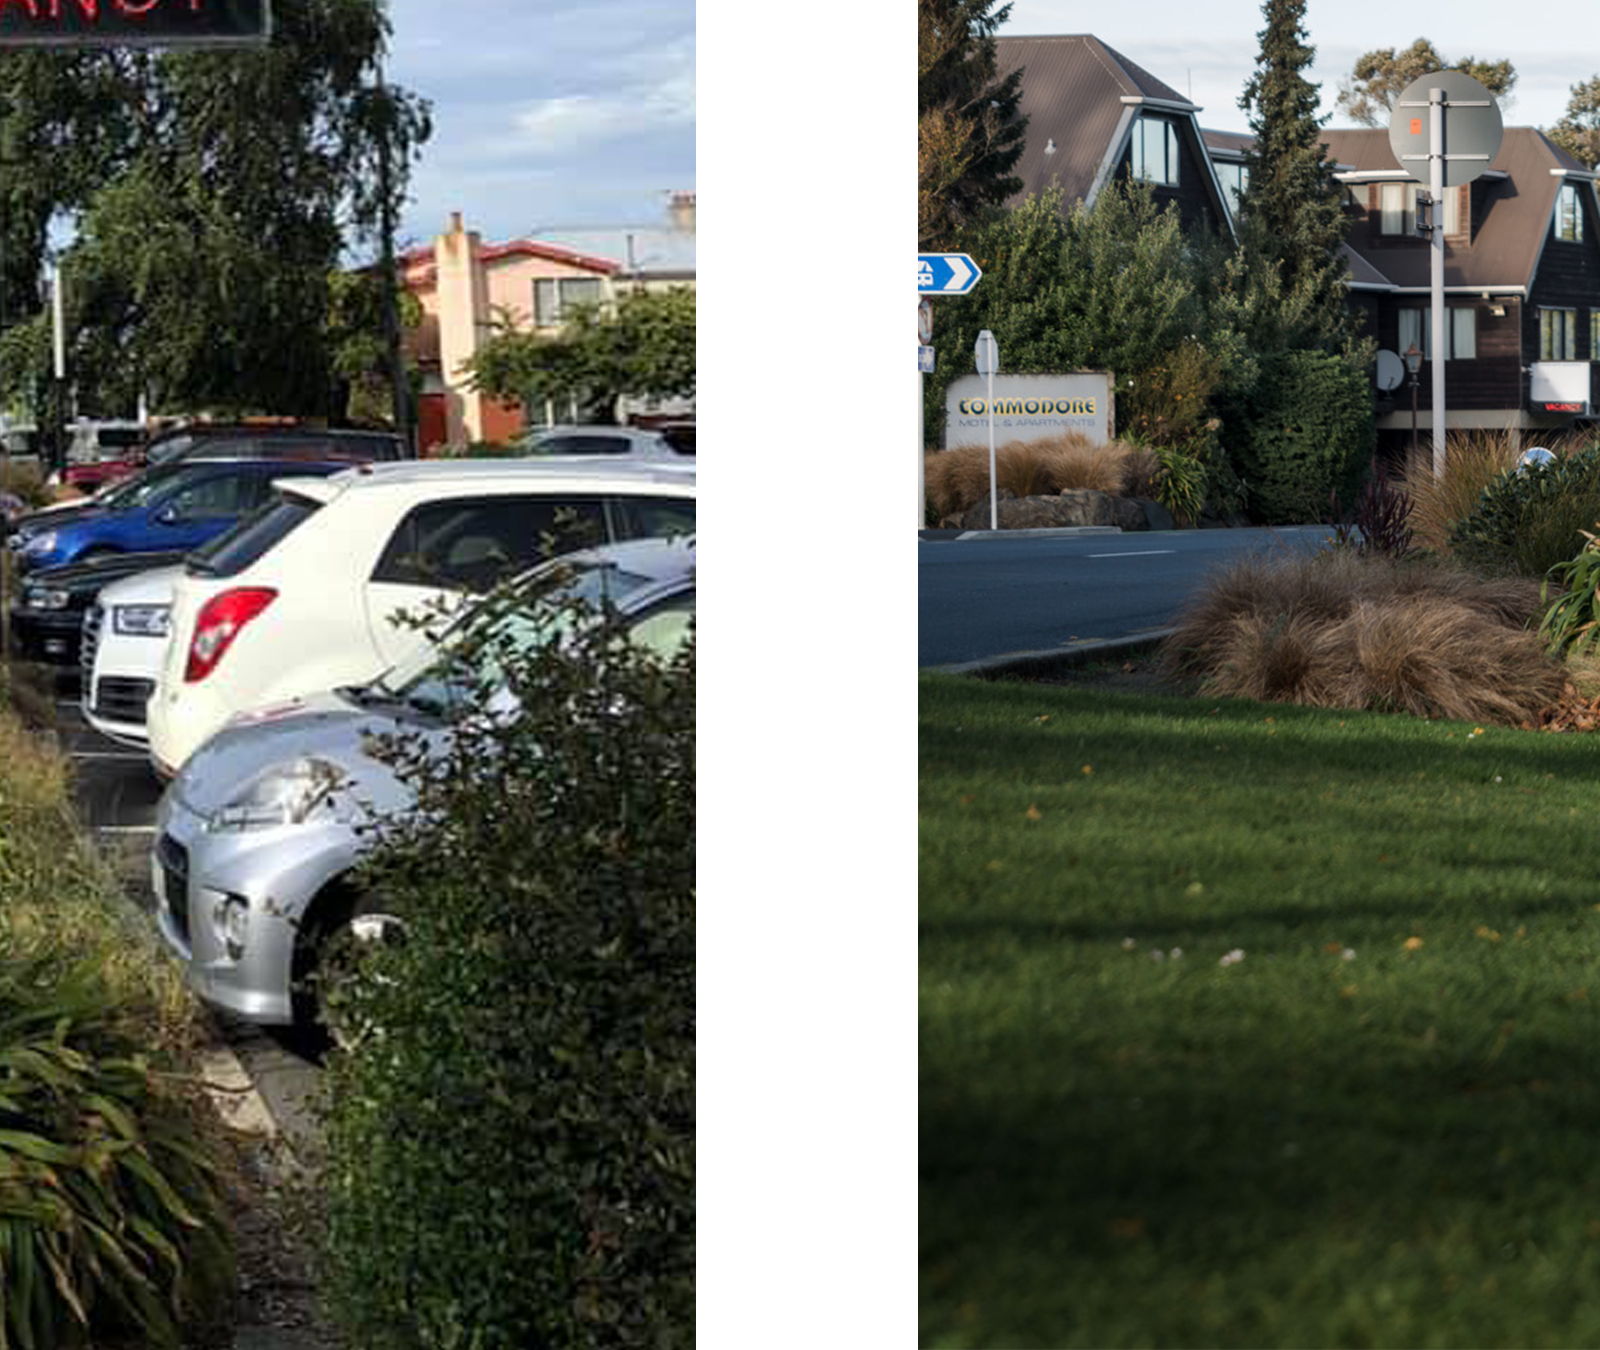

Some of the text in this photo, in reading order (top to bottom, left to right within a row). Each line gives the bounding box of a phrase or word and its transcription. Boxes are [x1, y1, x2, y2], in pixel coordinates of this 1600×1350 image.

[1544, 402, 1582, 412] VACANCY
[1003, 418, 1013, 428] &
[1015, 418, 1096, 428] APARTMENTS
